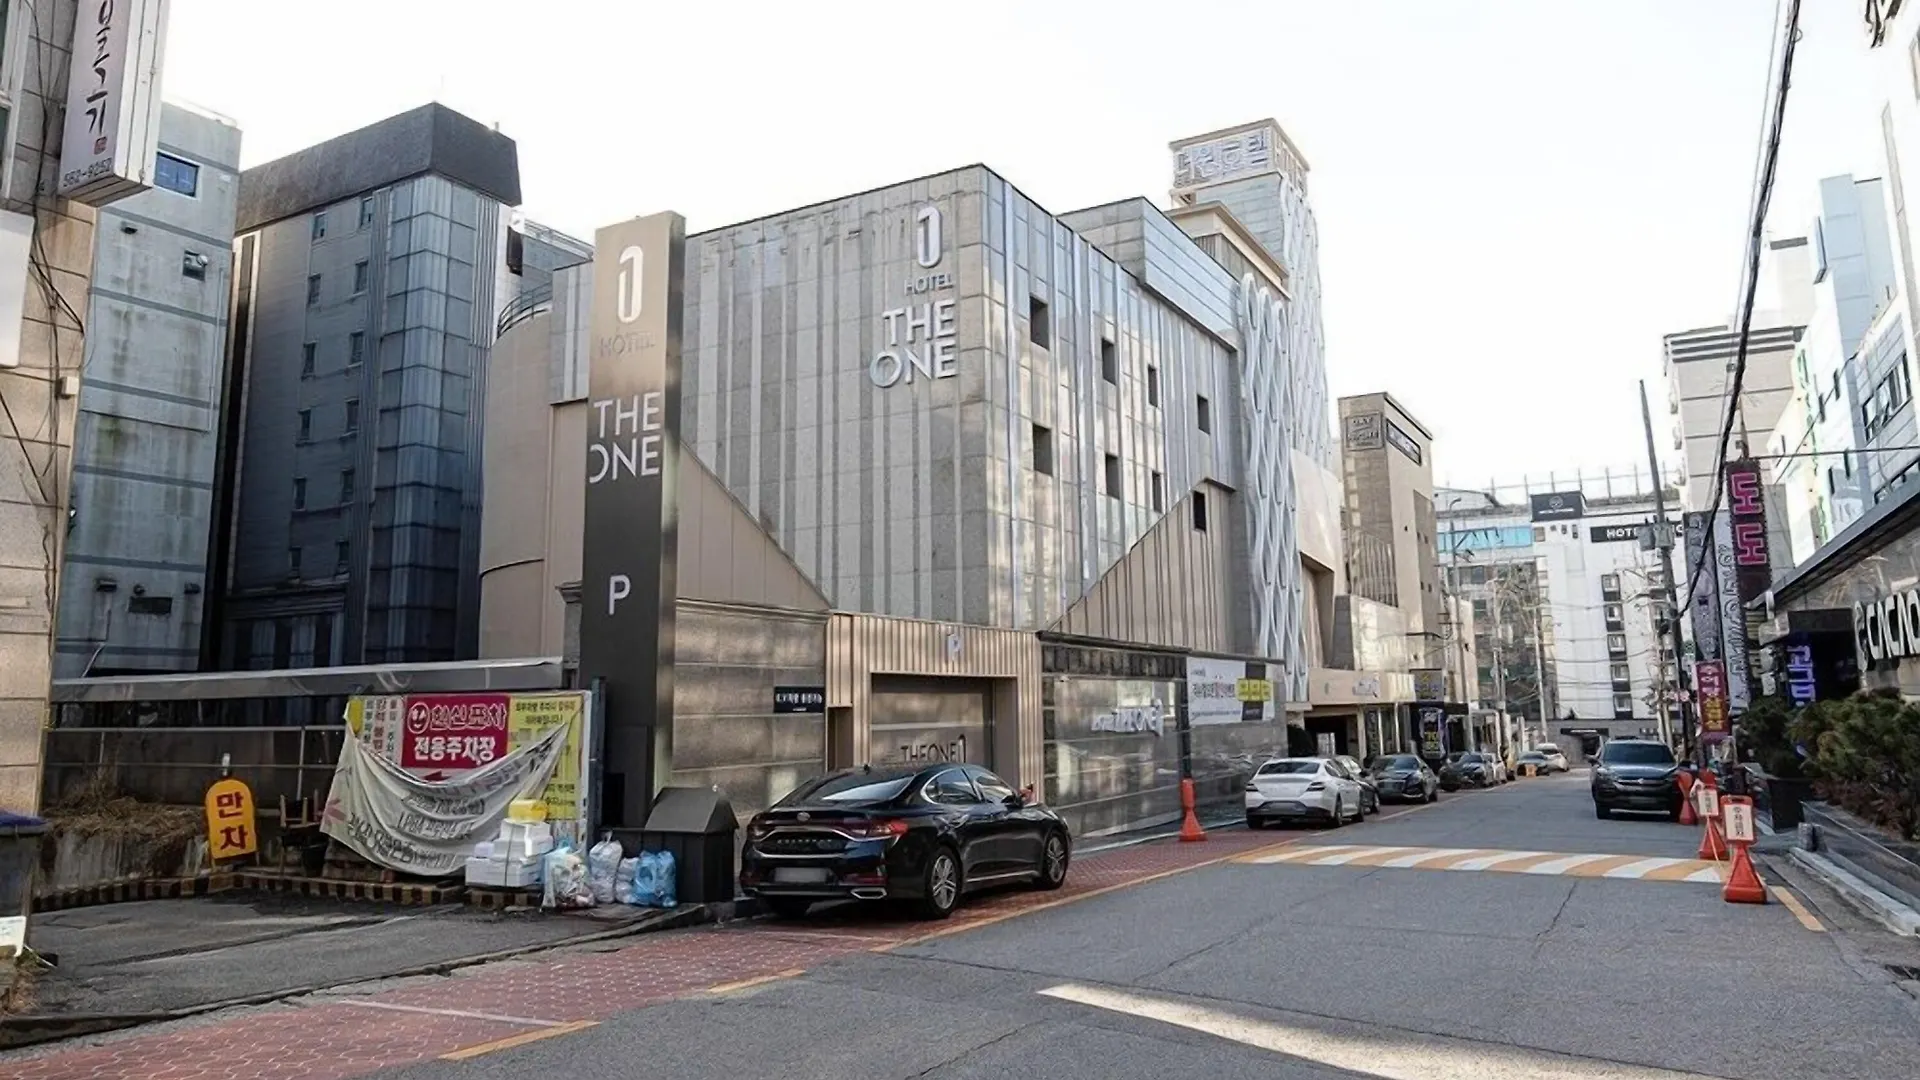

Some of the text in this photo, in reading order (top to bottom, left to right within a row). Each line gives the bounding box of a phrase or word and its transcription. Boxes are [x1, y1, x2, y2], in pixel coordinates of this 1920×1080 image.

[904, 273, 954, 295] HOTEL
[883, 298, 957, 346] THE
[598, 333, 655, 357] HOTEL
[869, 338, 958, 388] ONE
[593, 392, 661, 438] THE
[609, 575, 631, 615] P
[429, 703, 507, 730] 한신포차
[414, 735, 496, 765] 전용주차장
[216, 791, 249, 850] 만차
